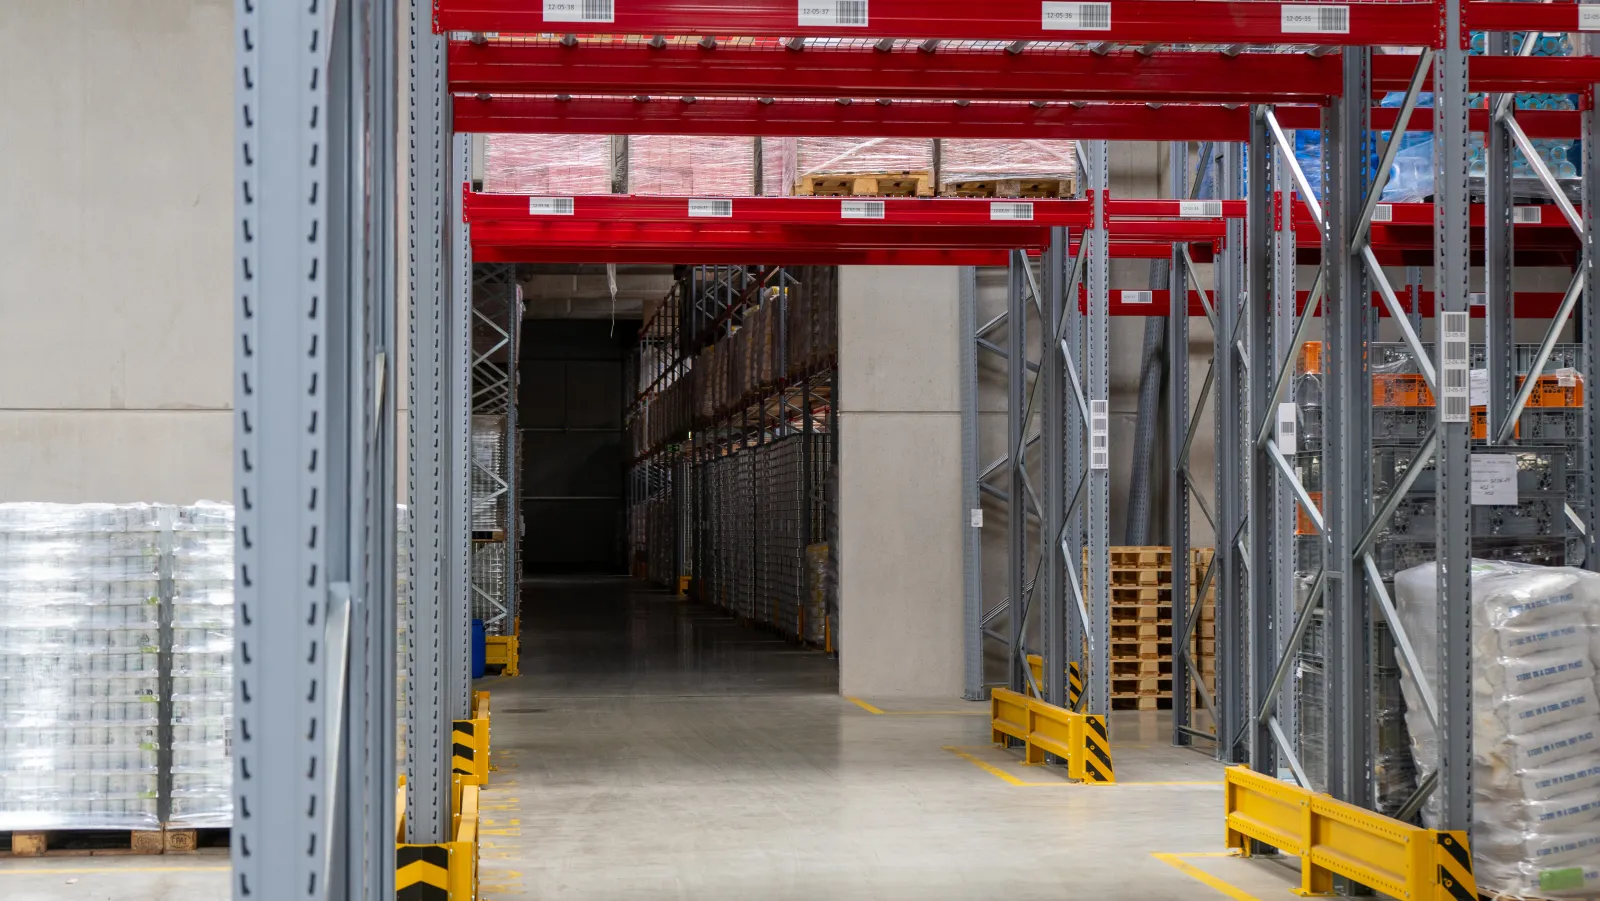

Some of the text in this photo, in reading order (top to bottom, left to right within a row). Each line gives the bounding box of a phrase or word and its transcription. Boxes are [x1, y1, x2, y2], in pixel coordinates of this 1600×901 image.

[1516, 672, 1532, 681] STORE
[1532, 670, 1539, 678] IN
[1544, 667, 1557, 675] COOL
[1568, 660, 1583, 670] PLACE
